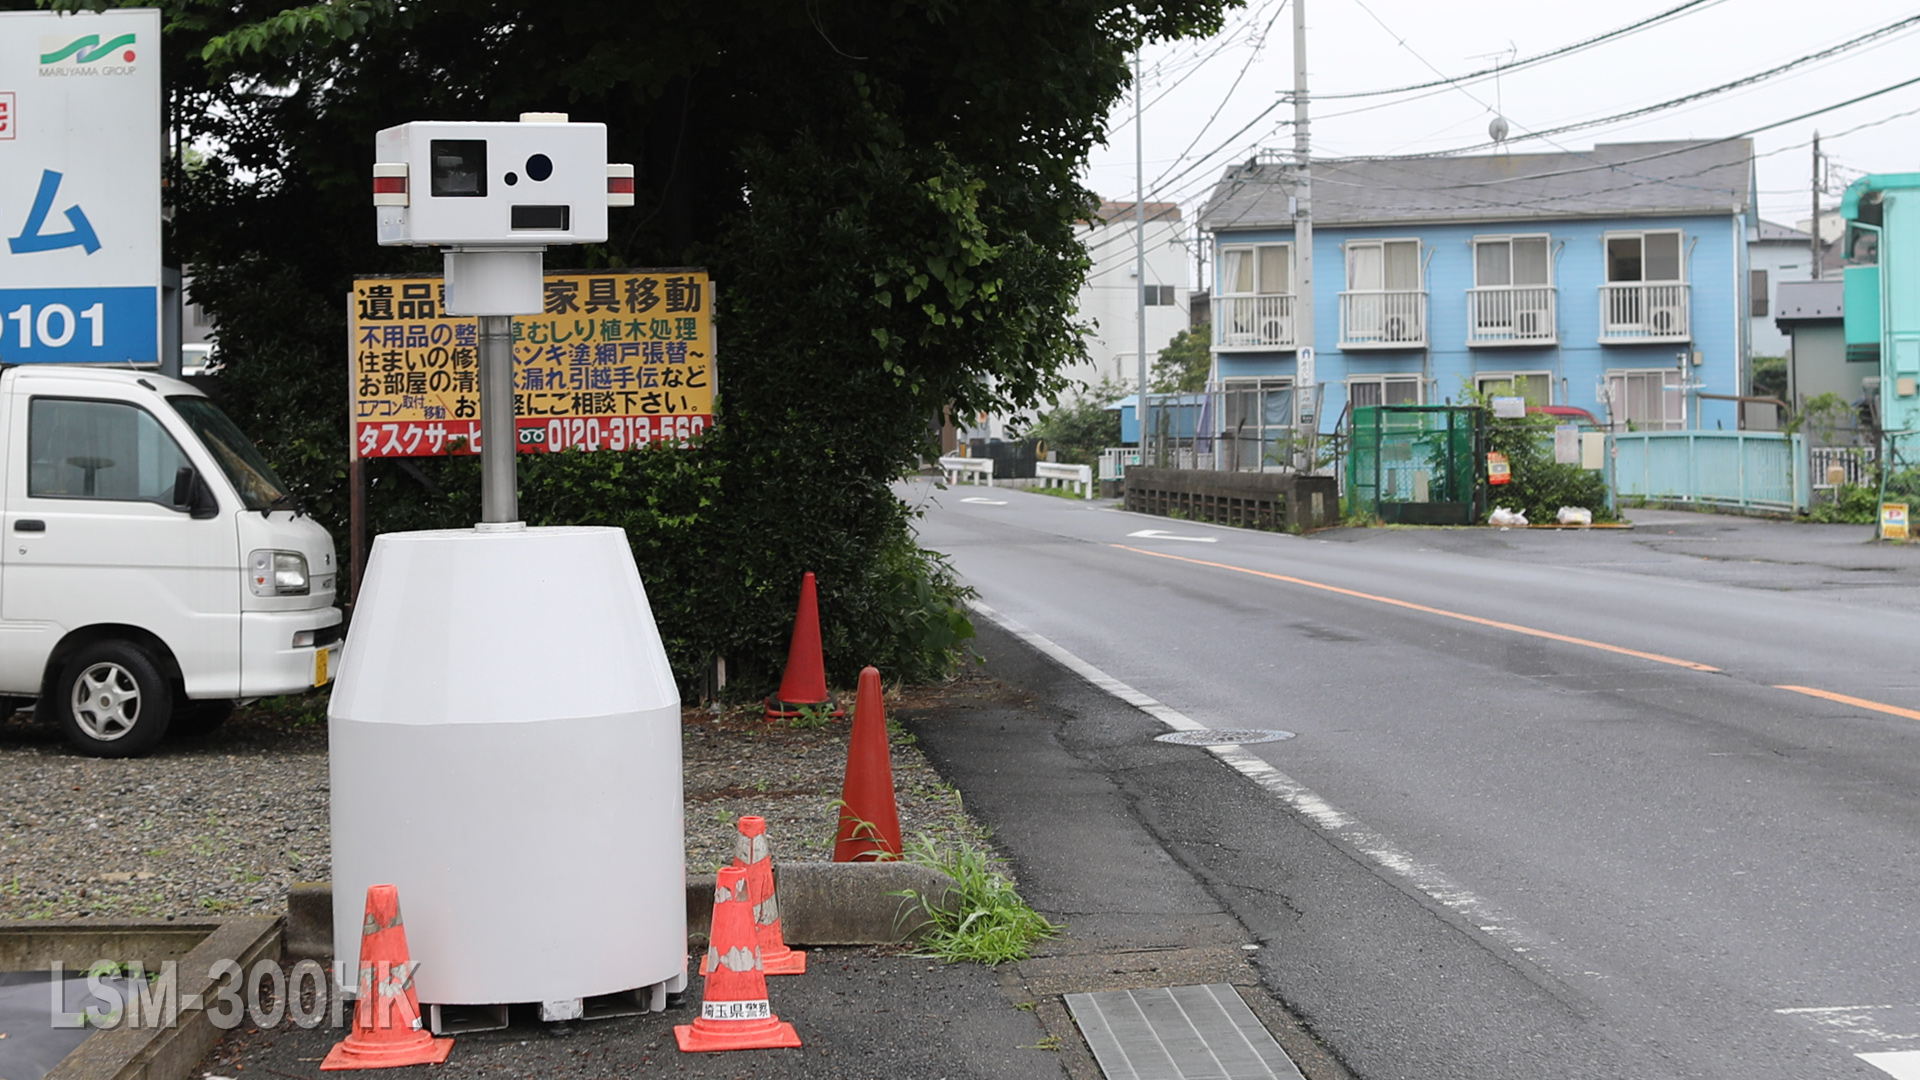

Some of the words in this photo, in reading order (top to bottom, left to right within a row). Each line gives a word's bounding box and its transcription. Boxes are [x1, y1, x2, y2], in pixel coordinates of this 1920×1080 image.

[39, 66, 98, 77] MARUYAMA
[102, 66, 136, 76] GROUP
[8, 169, 102, 256] ム
[544, 277, 701, 315] 家具移動
[0, 303, 104, 348] 101
[358, 346, 479, 373] 住まいの修
[359, 370, 480, 397] お部屋の清
[455, 395, 480, 418] お
[705, 1001, 768, 1018] 埼玉県警察
